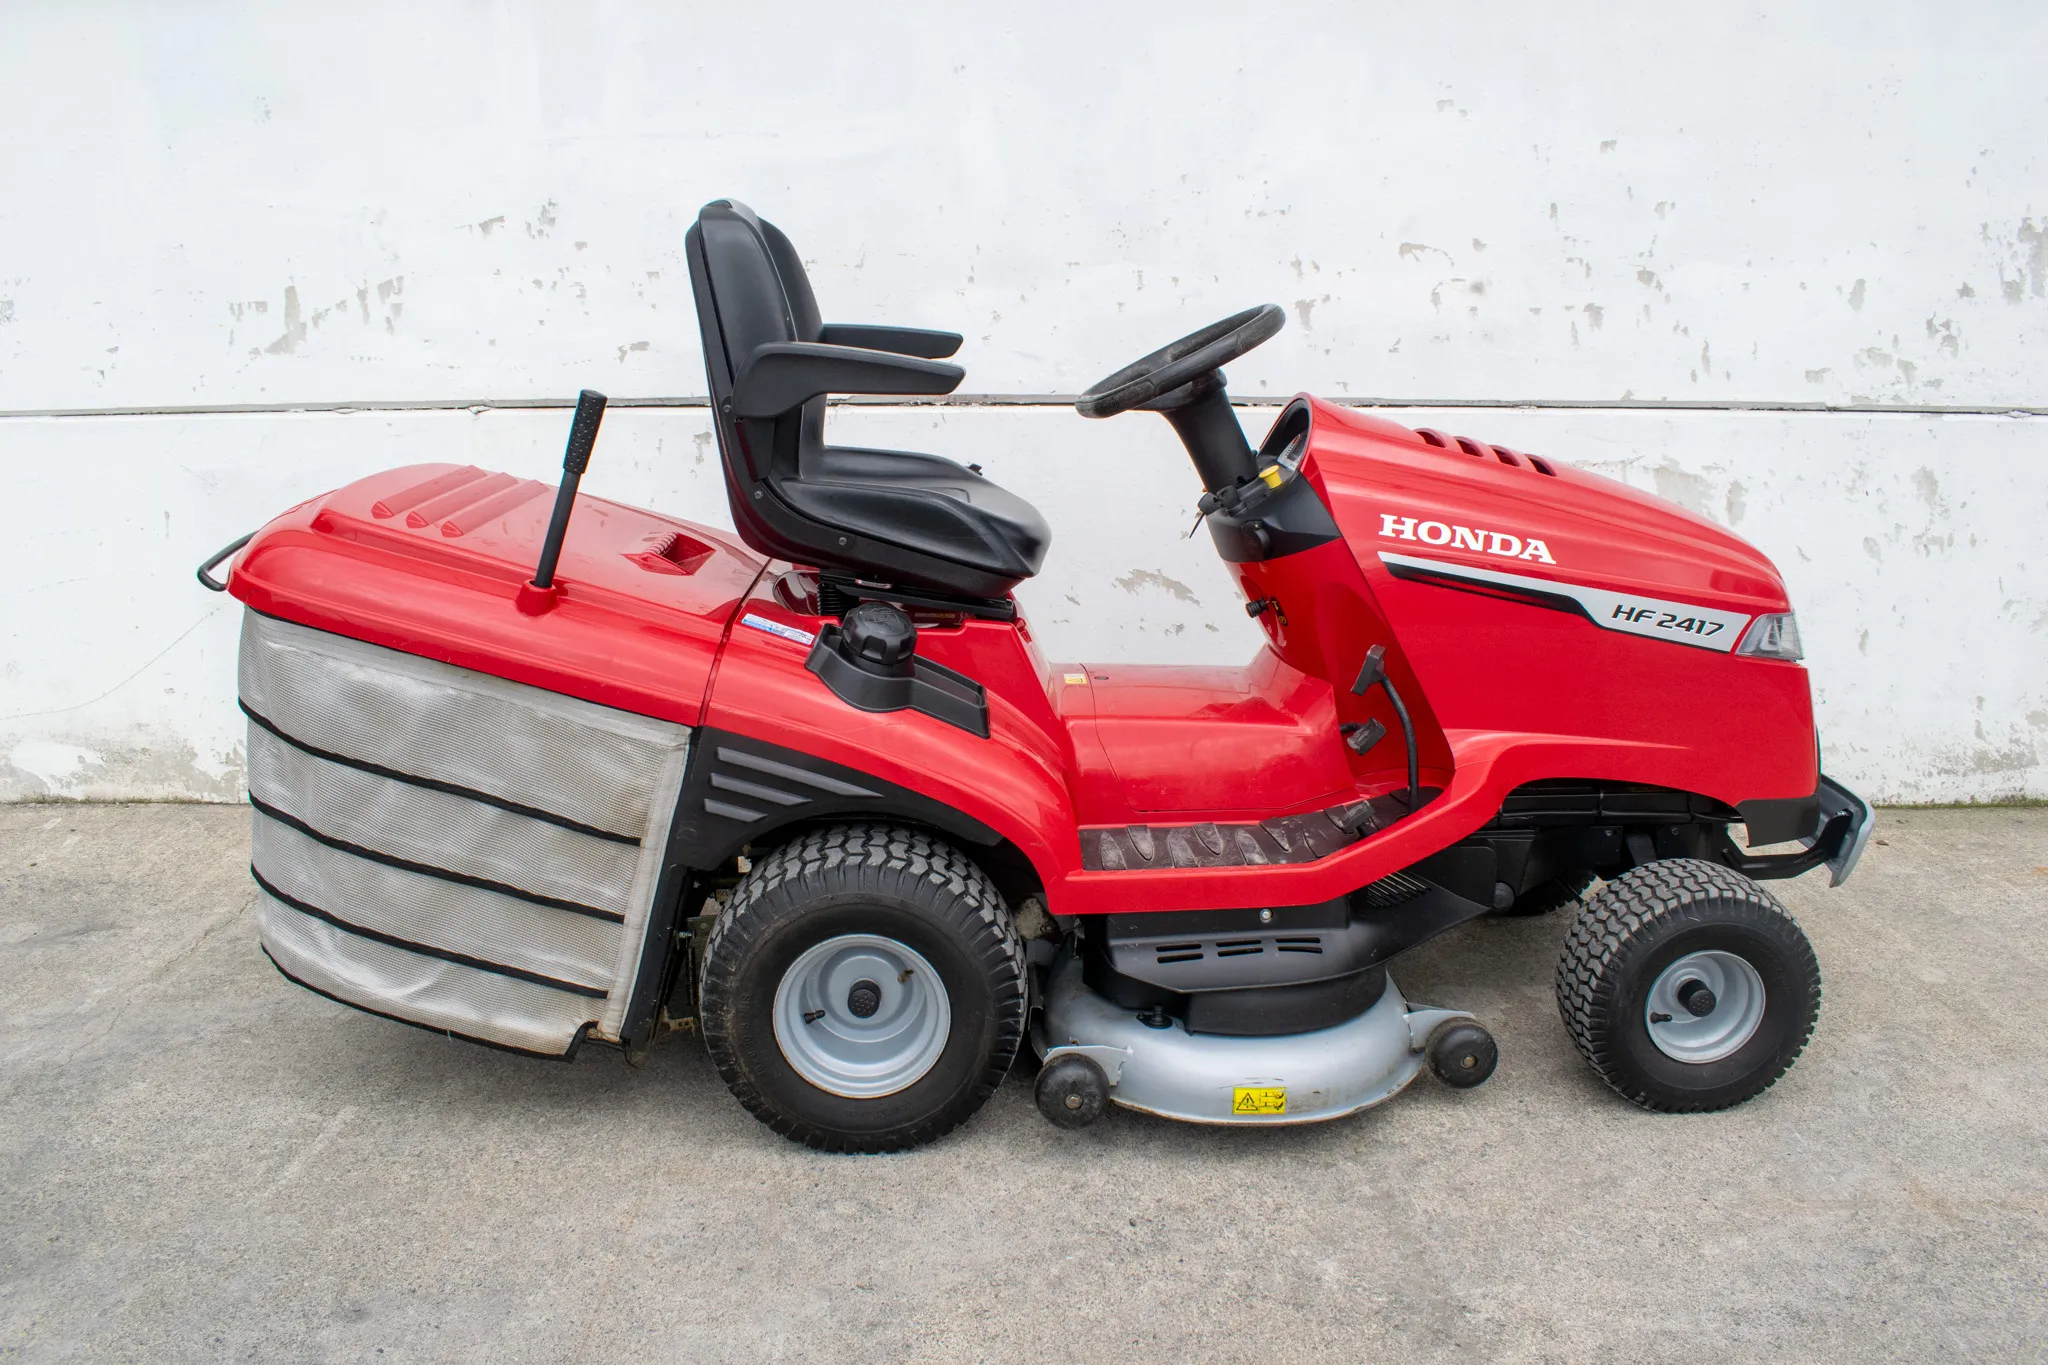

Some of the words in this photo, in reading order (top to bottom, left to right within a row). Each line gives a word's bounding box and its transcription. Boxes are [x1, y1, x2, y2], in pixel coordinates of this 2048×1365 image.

[1378, 513, 1557, 565] HONDA
[1611, 604, 1656, 623] HF
[1656, 612, 1725, 636] 2417
